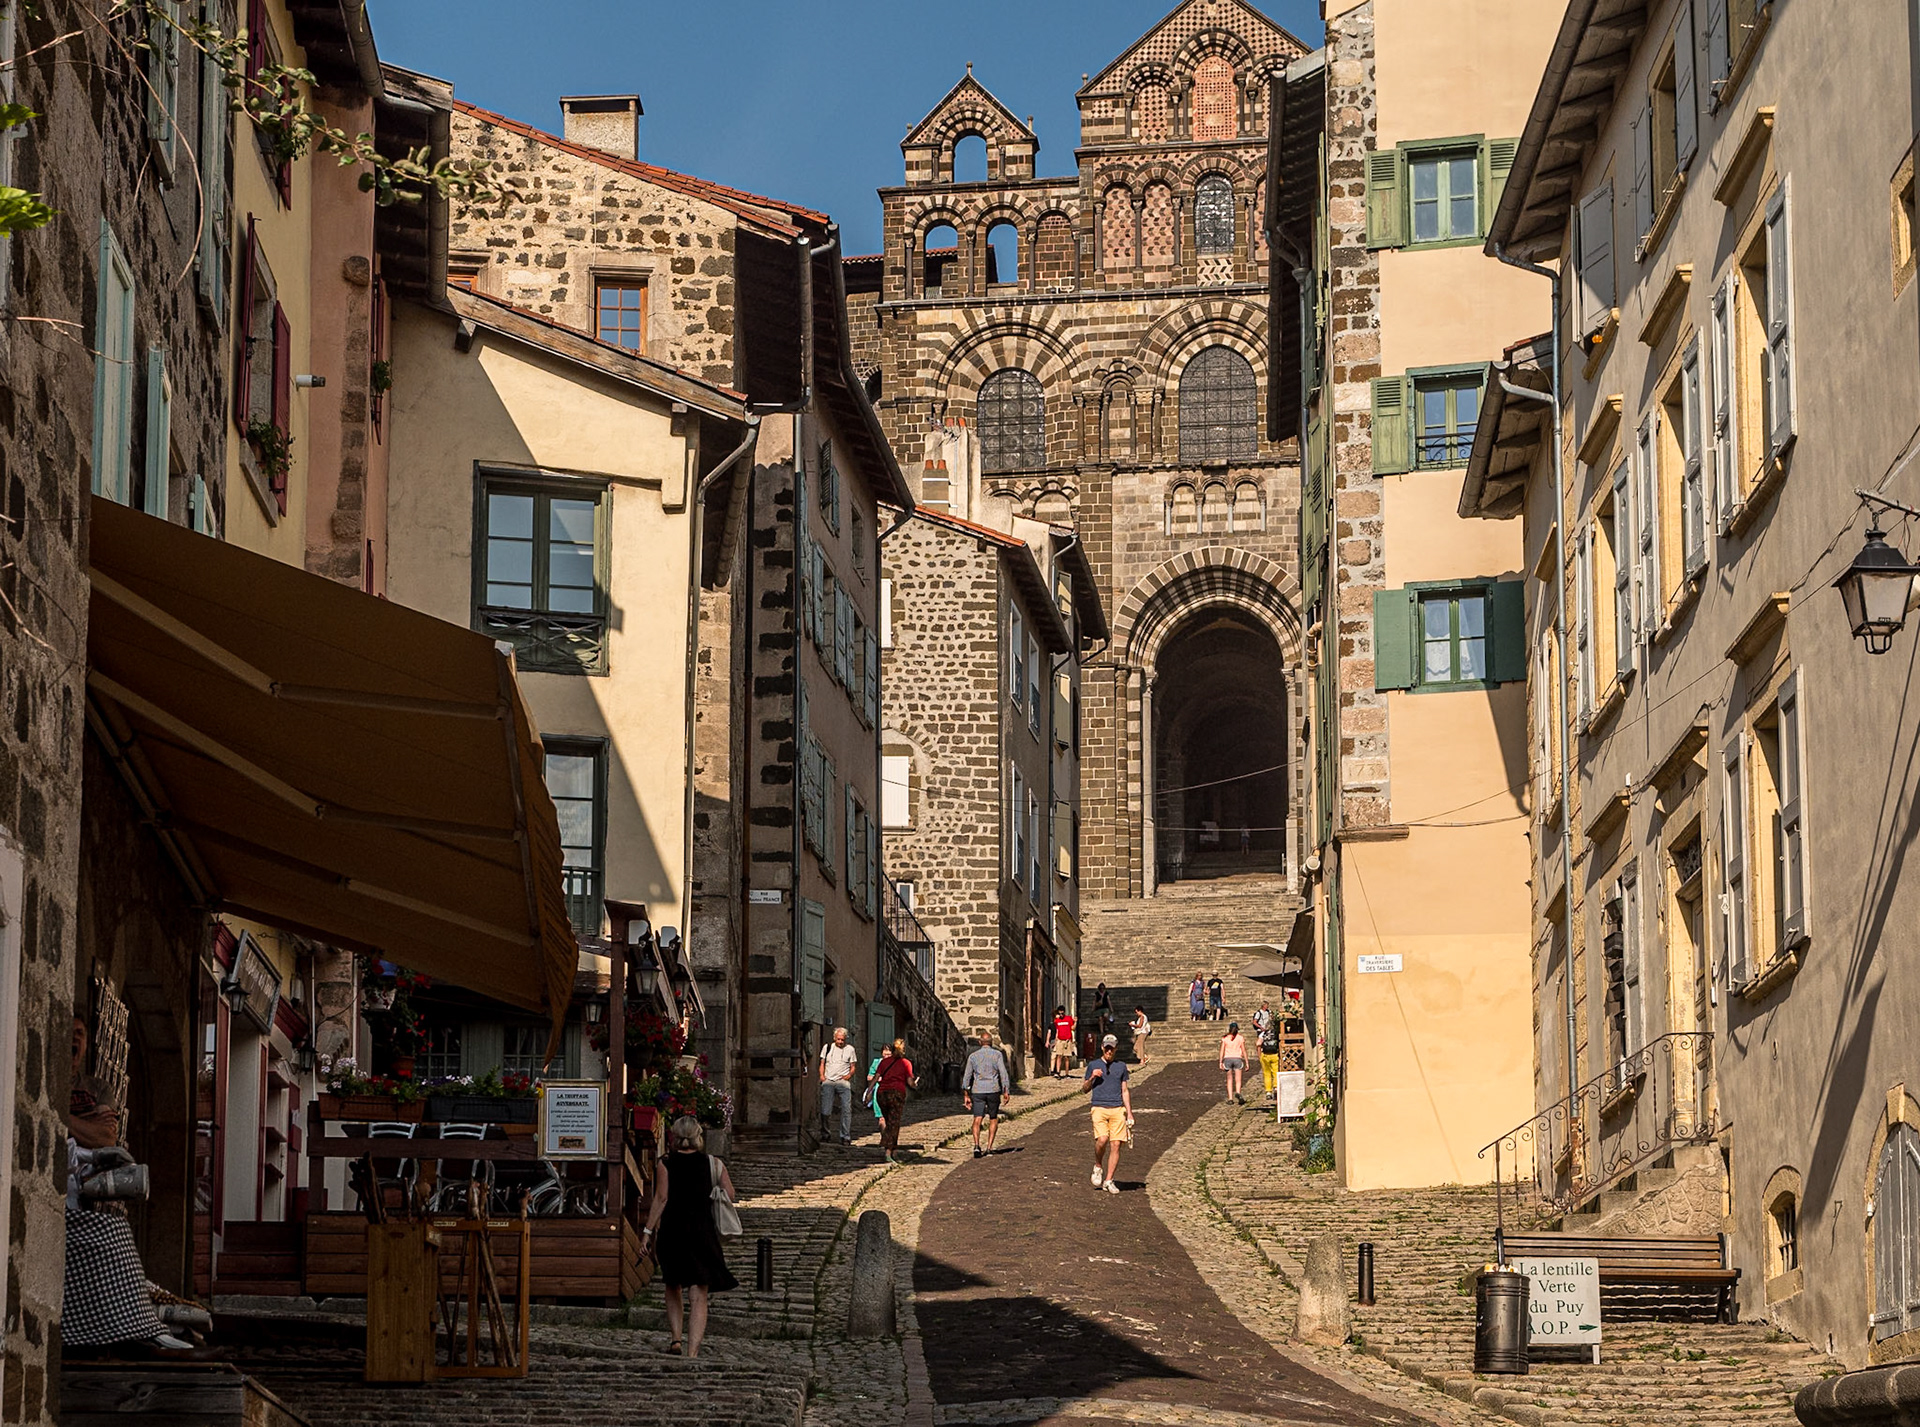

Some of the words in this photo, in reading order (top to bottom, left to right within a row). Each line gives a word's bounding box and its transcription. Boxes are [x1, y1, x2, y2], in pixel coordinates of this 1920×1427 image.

[1519, 1262, 1538, 1276] La
[1542, 1262, 1594, 1276] lentille
[1538, 1280, 1576, 1293] Verte
[1530, 1300, 1548, 1313] du
[1556, 1300, 1584, 1316] Puy
